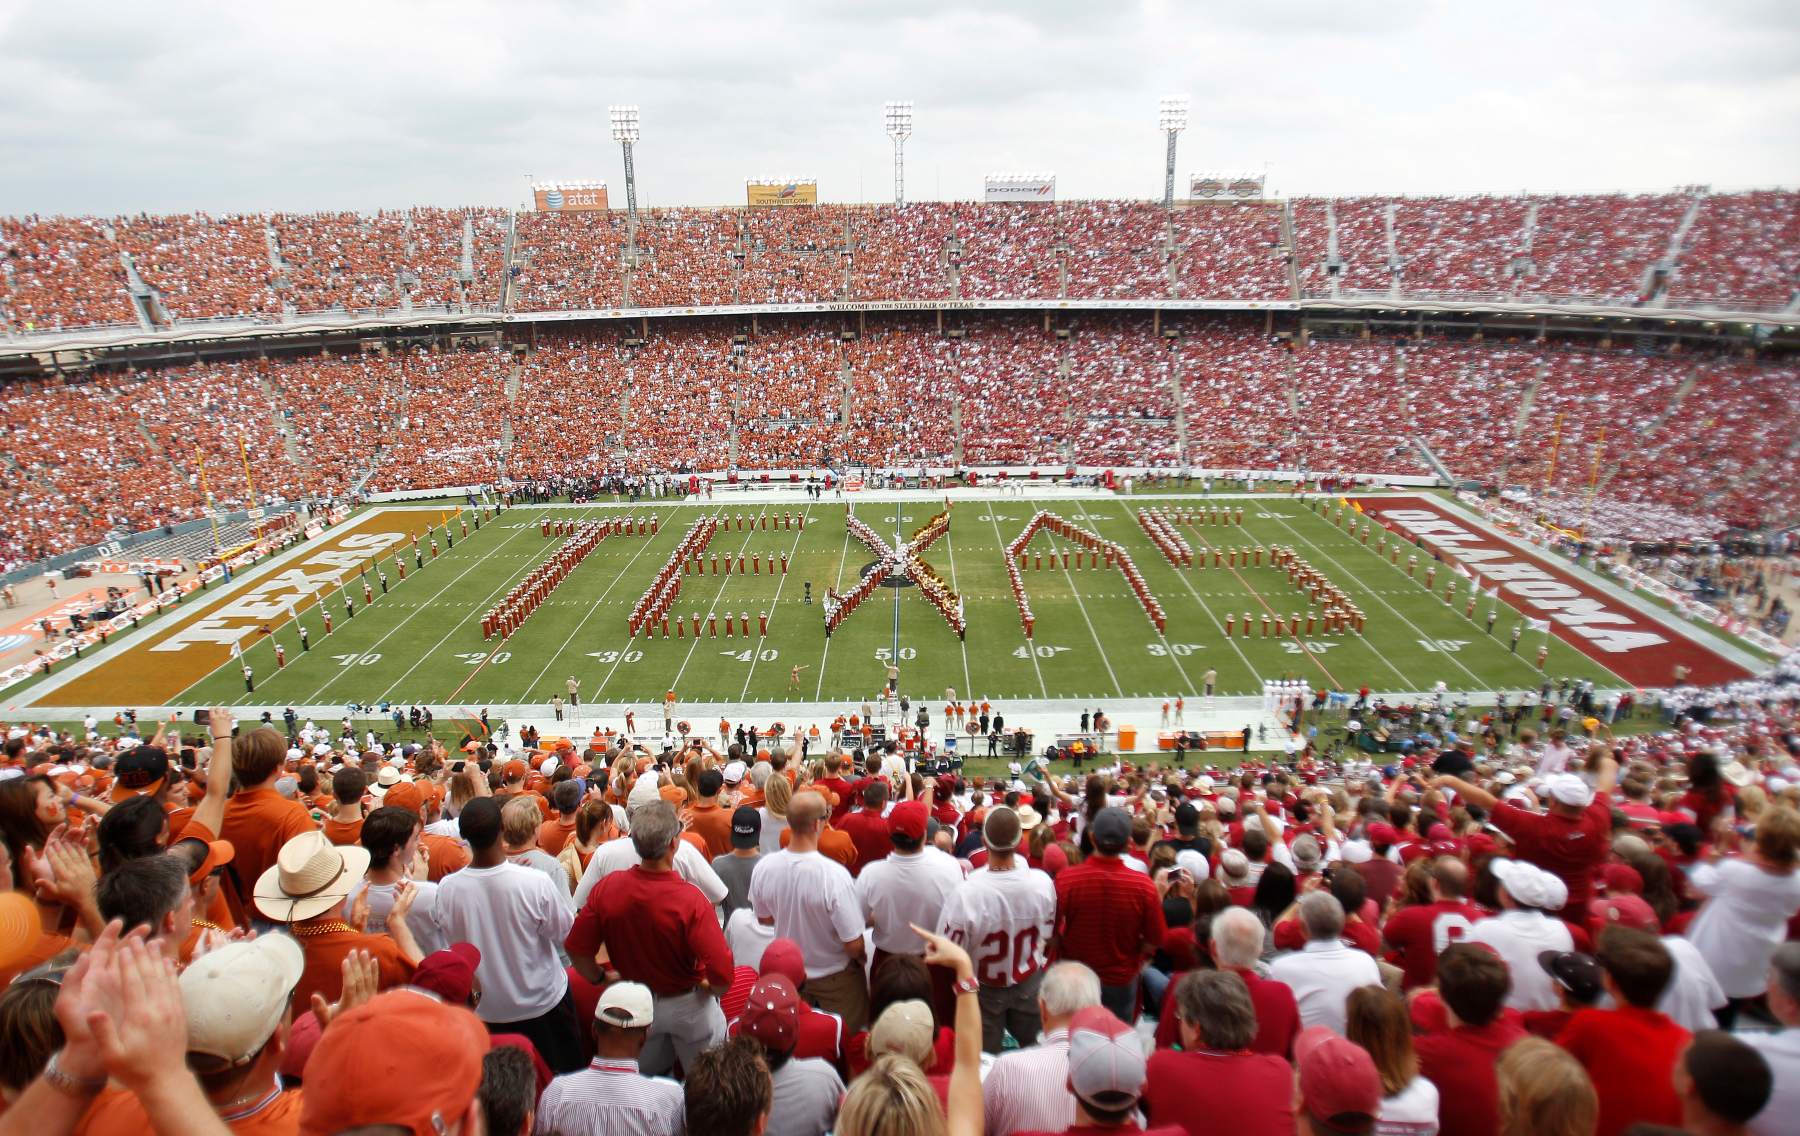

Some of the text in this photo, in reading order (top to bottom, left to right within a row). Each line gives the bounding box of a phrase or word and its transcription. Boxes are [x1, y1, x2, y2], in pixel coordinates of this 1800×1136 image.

[568, 192, 599, 206] at&t
[829, 303, 869, 311] WELCOME
[1379, 508, 1671, 653] OKLAHOMA
[148, 532, 405, 652] TEXAS
[1146, 644, 1193, 656] 30
[1277, 641, 1328, 654] 20
[1417, 639, 1461, 652] 10
[464, 652, 512, 665] 20
[598, 650, 644, 663] 30
[735, 649, 780, 662] 40
[874, 647, 917, 660] 50
[1012, 646, 1055, 659] 40
[337, 653, 383, 666] 10
[977, 925, 1040, 987] 20
